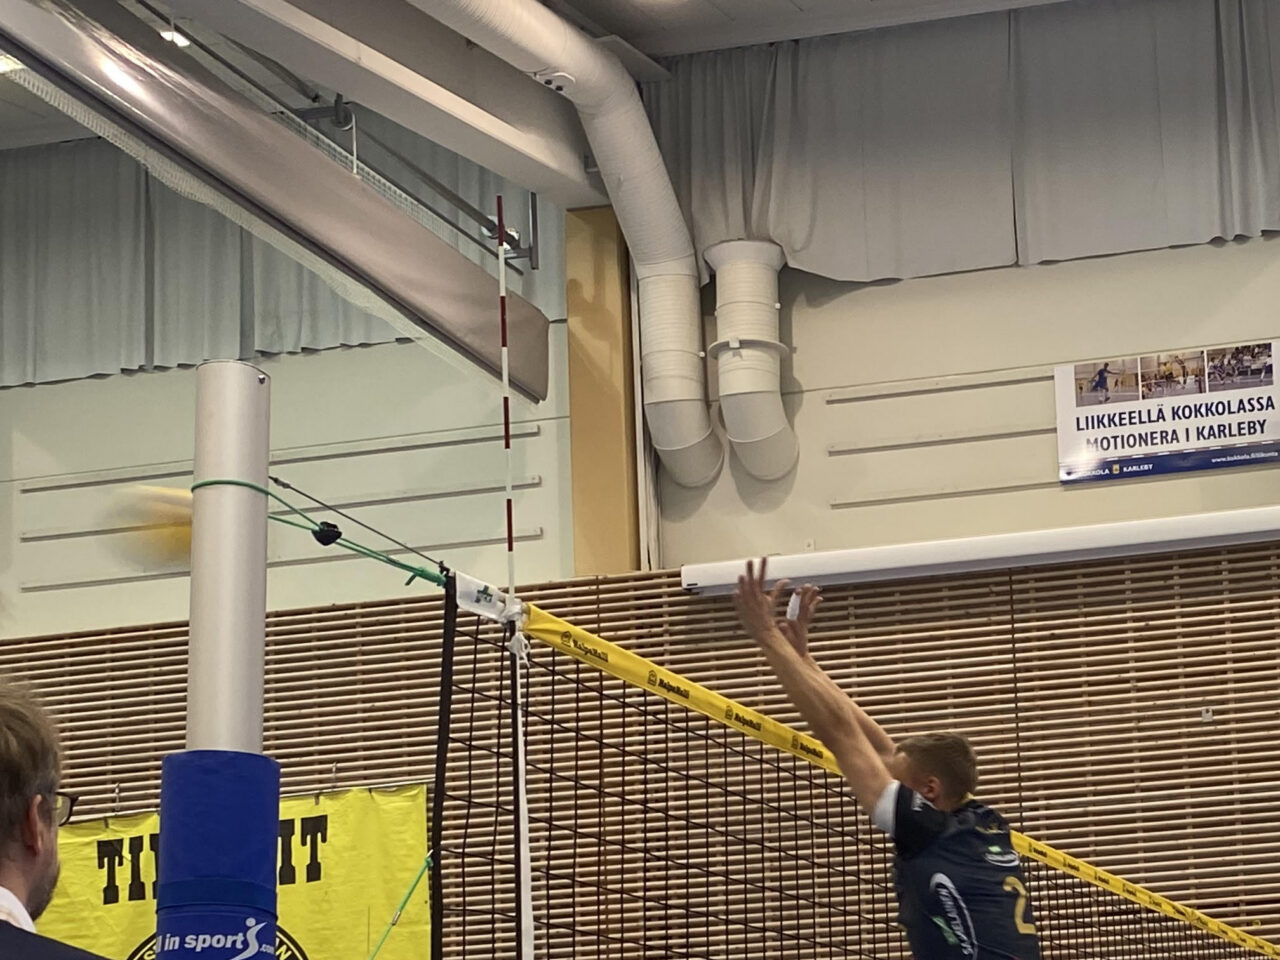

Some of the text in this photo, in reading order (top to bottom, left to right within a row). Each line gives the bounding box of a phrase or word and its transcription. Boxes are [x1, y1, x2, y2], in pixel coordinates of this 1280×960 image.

[1076, 395, 1275, 431] LIIKKEELLÄ KOKKOLASSA
[1086, 429, 1180, 452] MOTIONERA
[1196, 419, 1267, 441] KARLEBY
[1123, 464, 1153, 473] KARLEBY
[1002, 875, 1037, 934] 2
[164, 933, 180, 951] in
